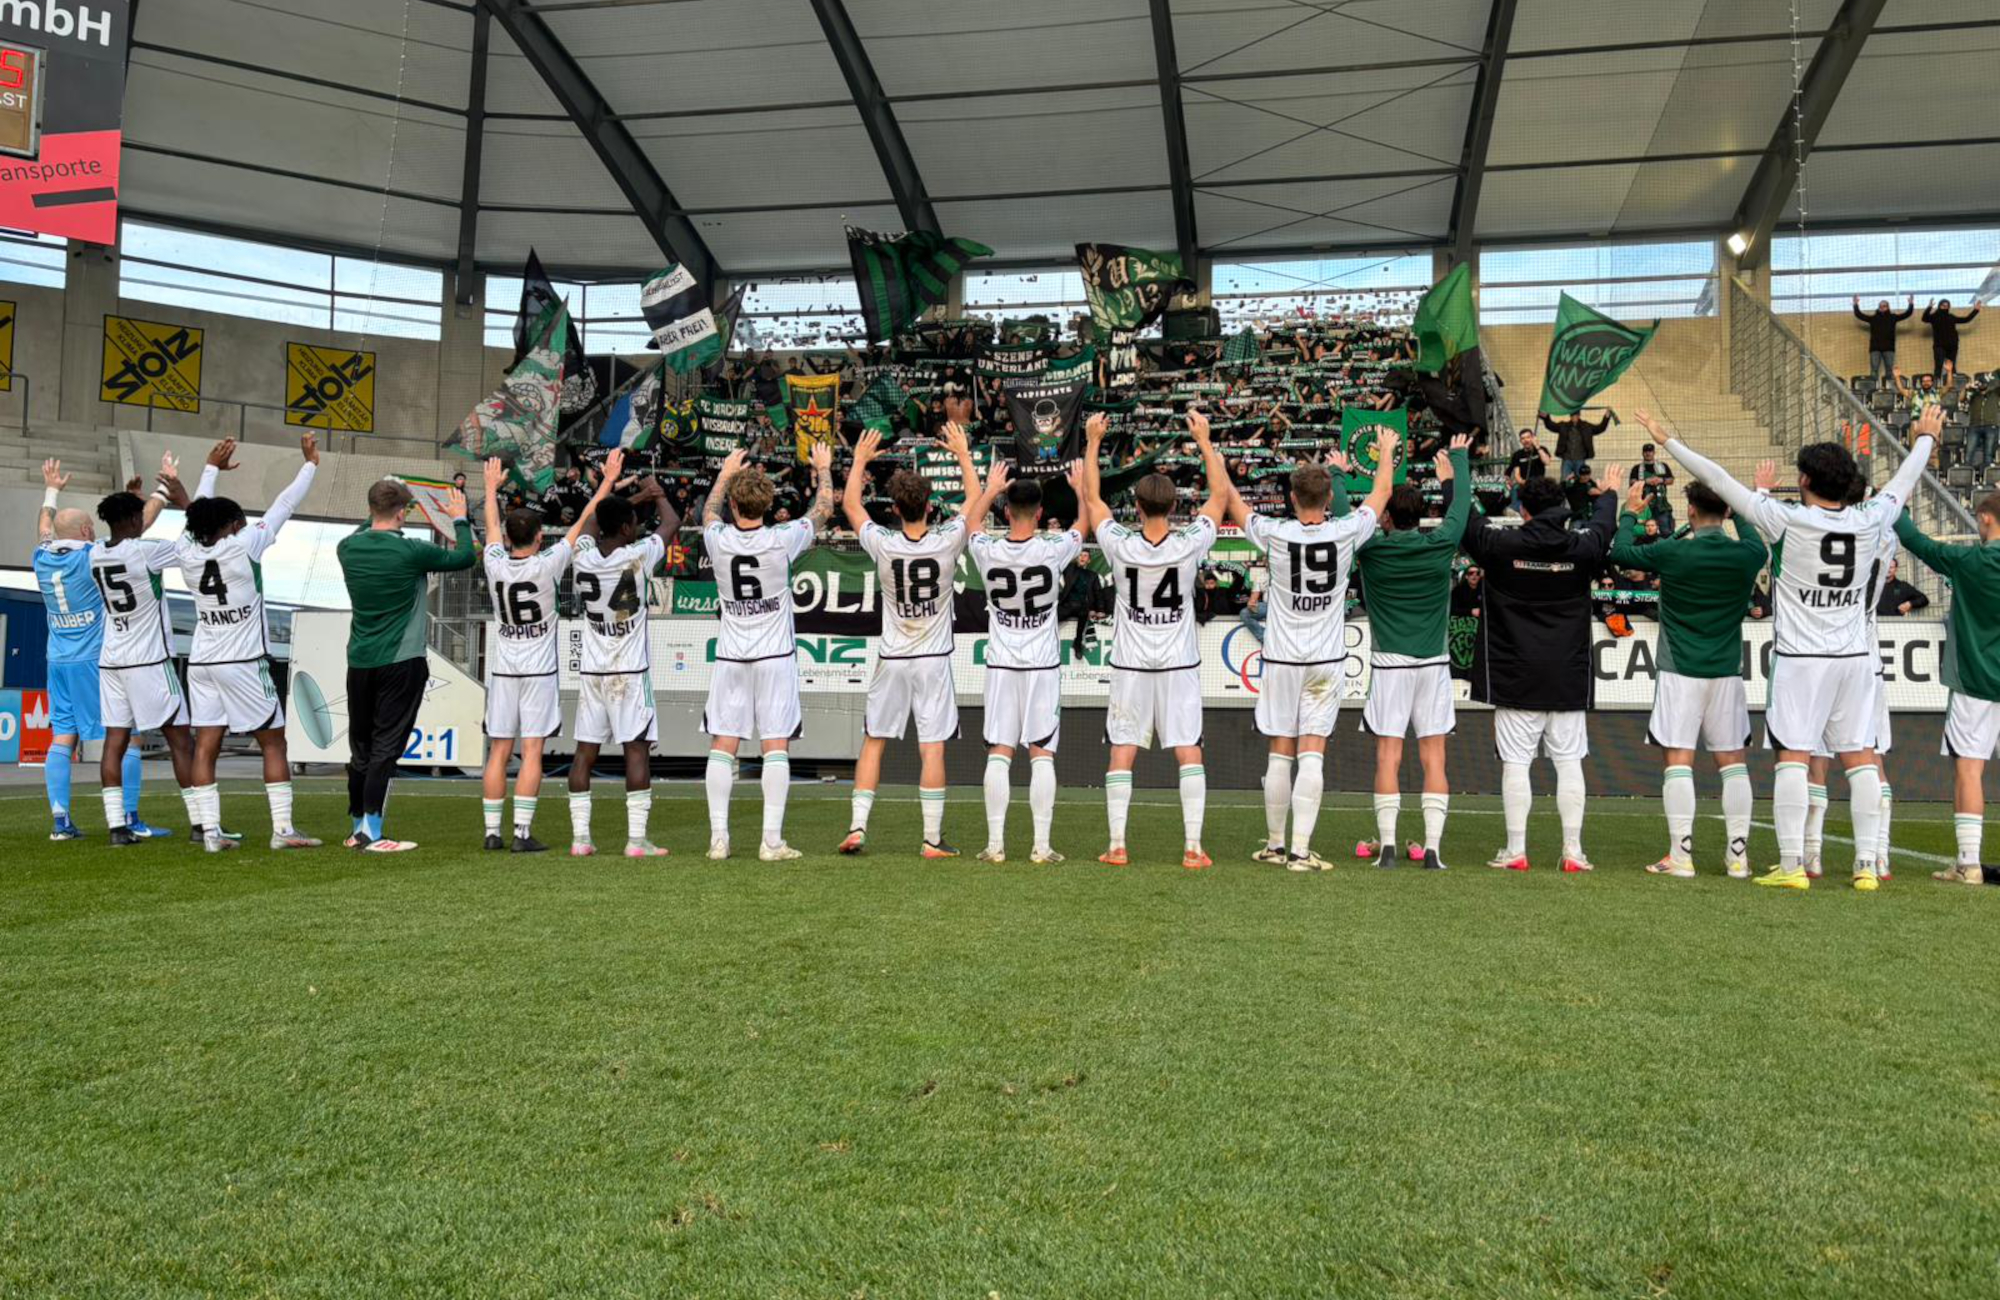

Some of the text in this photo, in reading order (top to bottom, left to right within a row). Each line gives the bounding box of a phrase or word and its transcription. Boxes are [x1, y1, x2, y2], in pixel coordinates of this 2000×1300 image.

[2, 92, 28, 109] ST
[117, 321, 147, 351] HEIZUNG
[118, 335, 138, 356] KLIMA
[299, 360, 318, 381] KLIMA
[978, 357, 1049, 374] UNTERLAND
[993, 350, 1034, 363] SZENE
[1021, 461, 1071, 473] UNTERLAN
[1288, 541, 1338, 594] 19
[1818, 531, 1856, 588] 9
[51, 570, 69, 614] 1
[92, 564, 137, 614] 15
[199, 559, 228, 605] 4
[731, 555, 762, 601] 6
[892, 557, 940, 604] 18
[987, 564, 1053, 617] 22
[1125, 567, 1183, 613] 14
[495, 581, 542, 626] 16
[576, 568, 640, 622] 24
[896, 601, 939, 618] LECHL
[1292, 595, 1332, 611] KOPP
[1798, 587, 1861, 608] YILMAZ
[51, 611, 95, 629] AUBER
[113, 616, 129, 631] SY
[199, 605, 251, 626] RANCIS
[402, 728, 453, 761] 2:1
